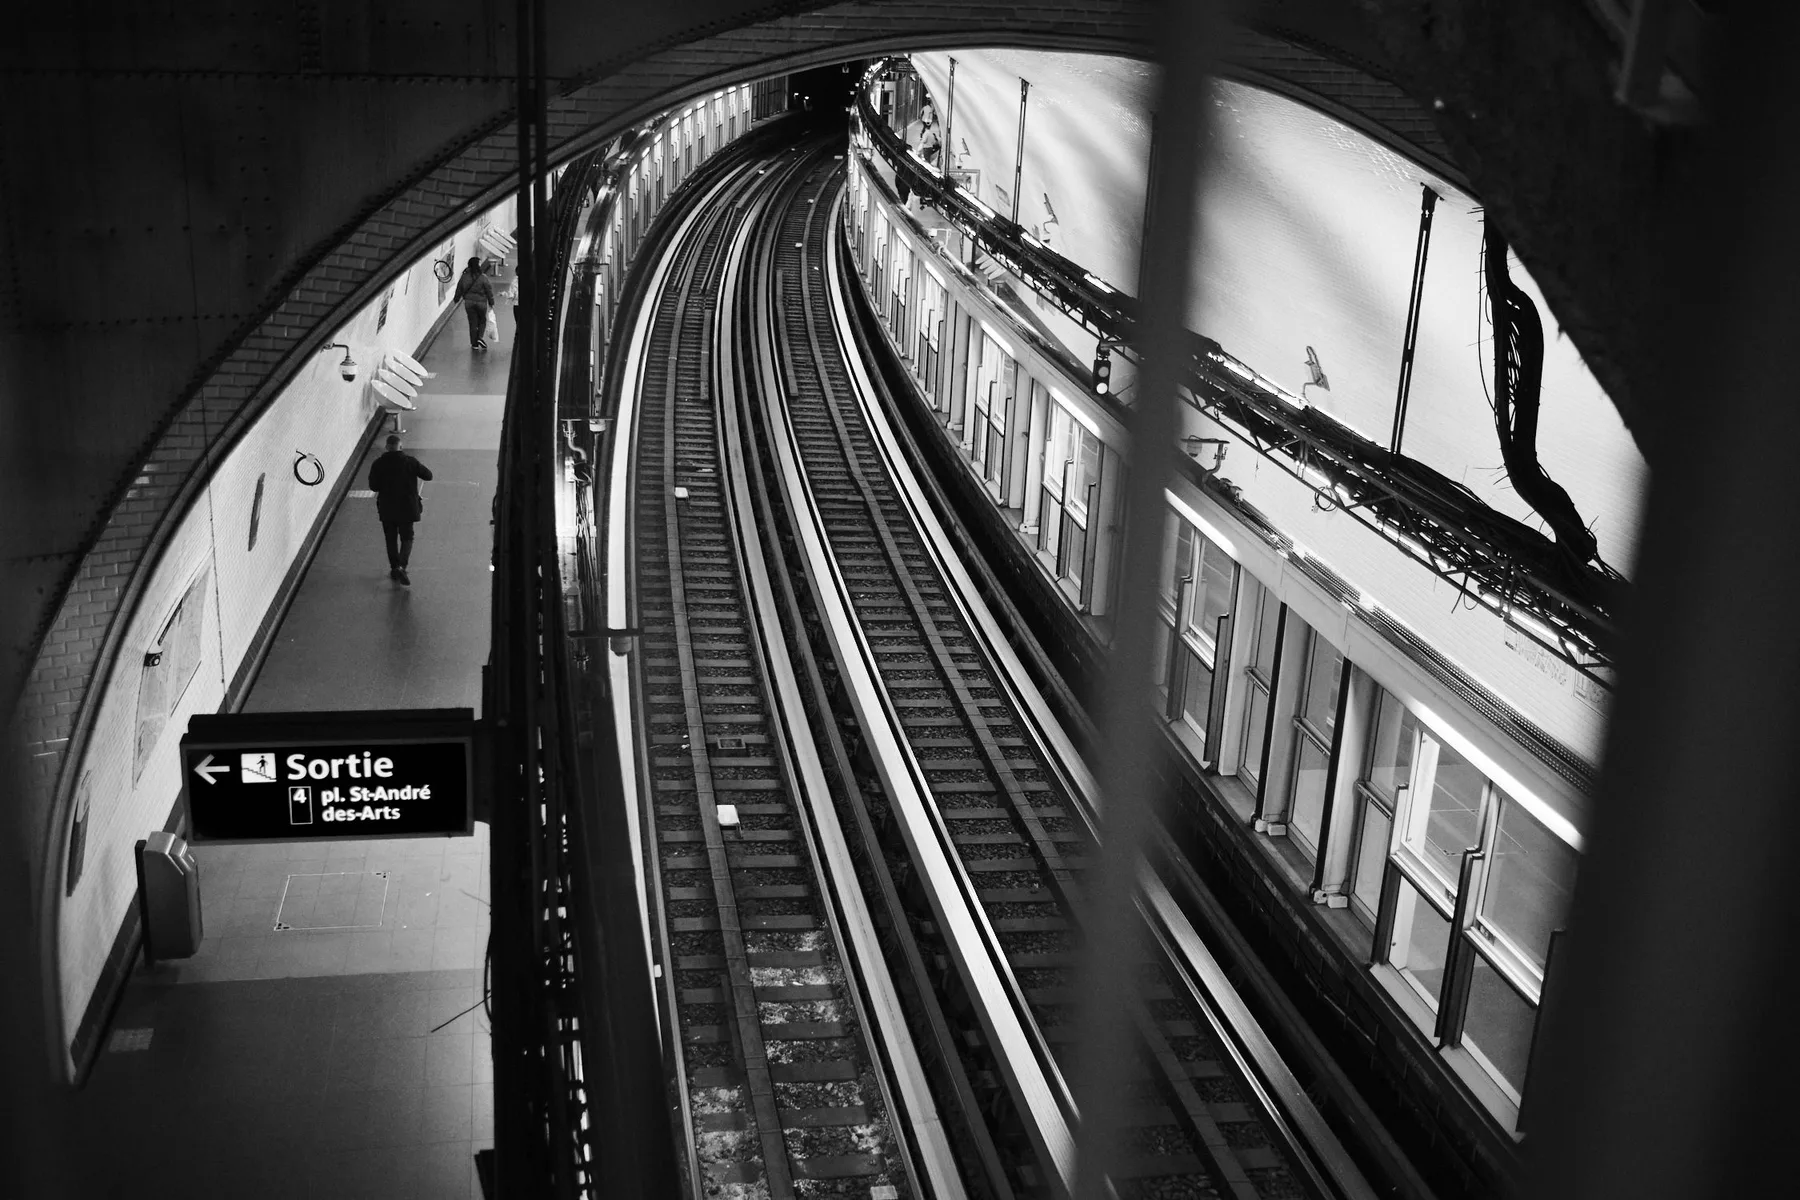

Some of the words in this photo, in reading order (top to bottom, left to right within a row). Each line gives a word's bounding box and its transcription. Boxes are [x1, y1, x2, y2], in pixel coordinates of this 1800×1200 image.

[286, 751, 394, 780] Sortie
[293, 788, 307, 804] 4
[321, 787, 346, 806] pl.
[350, 785, 431, 803] St-André
[322, 806, 401, 822] des-Arts
